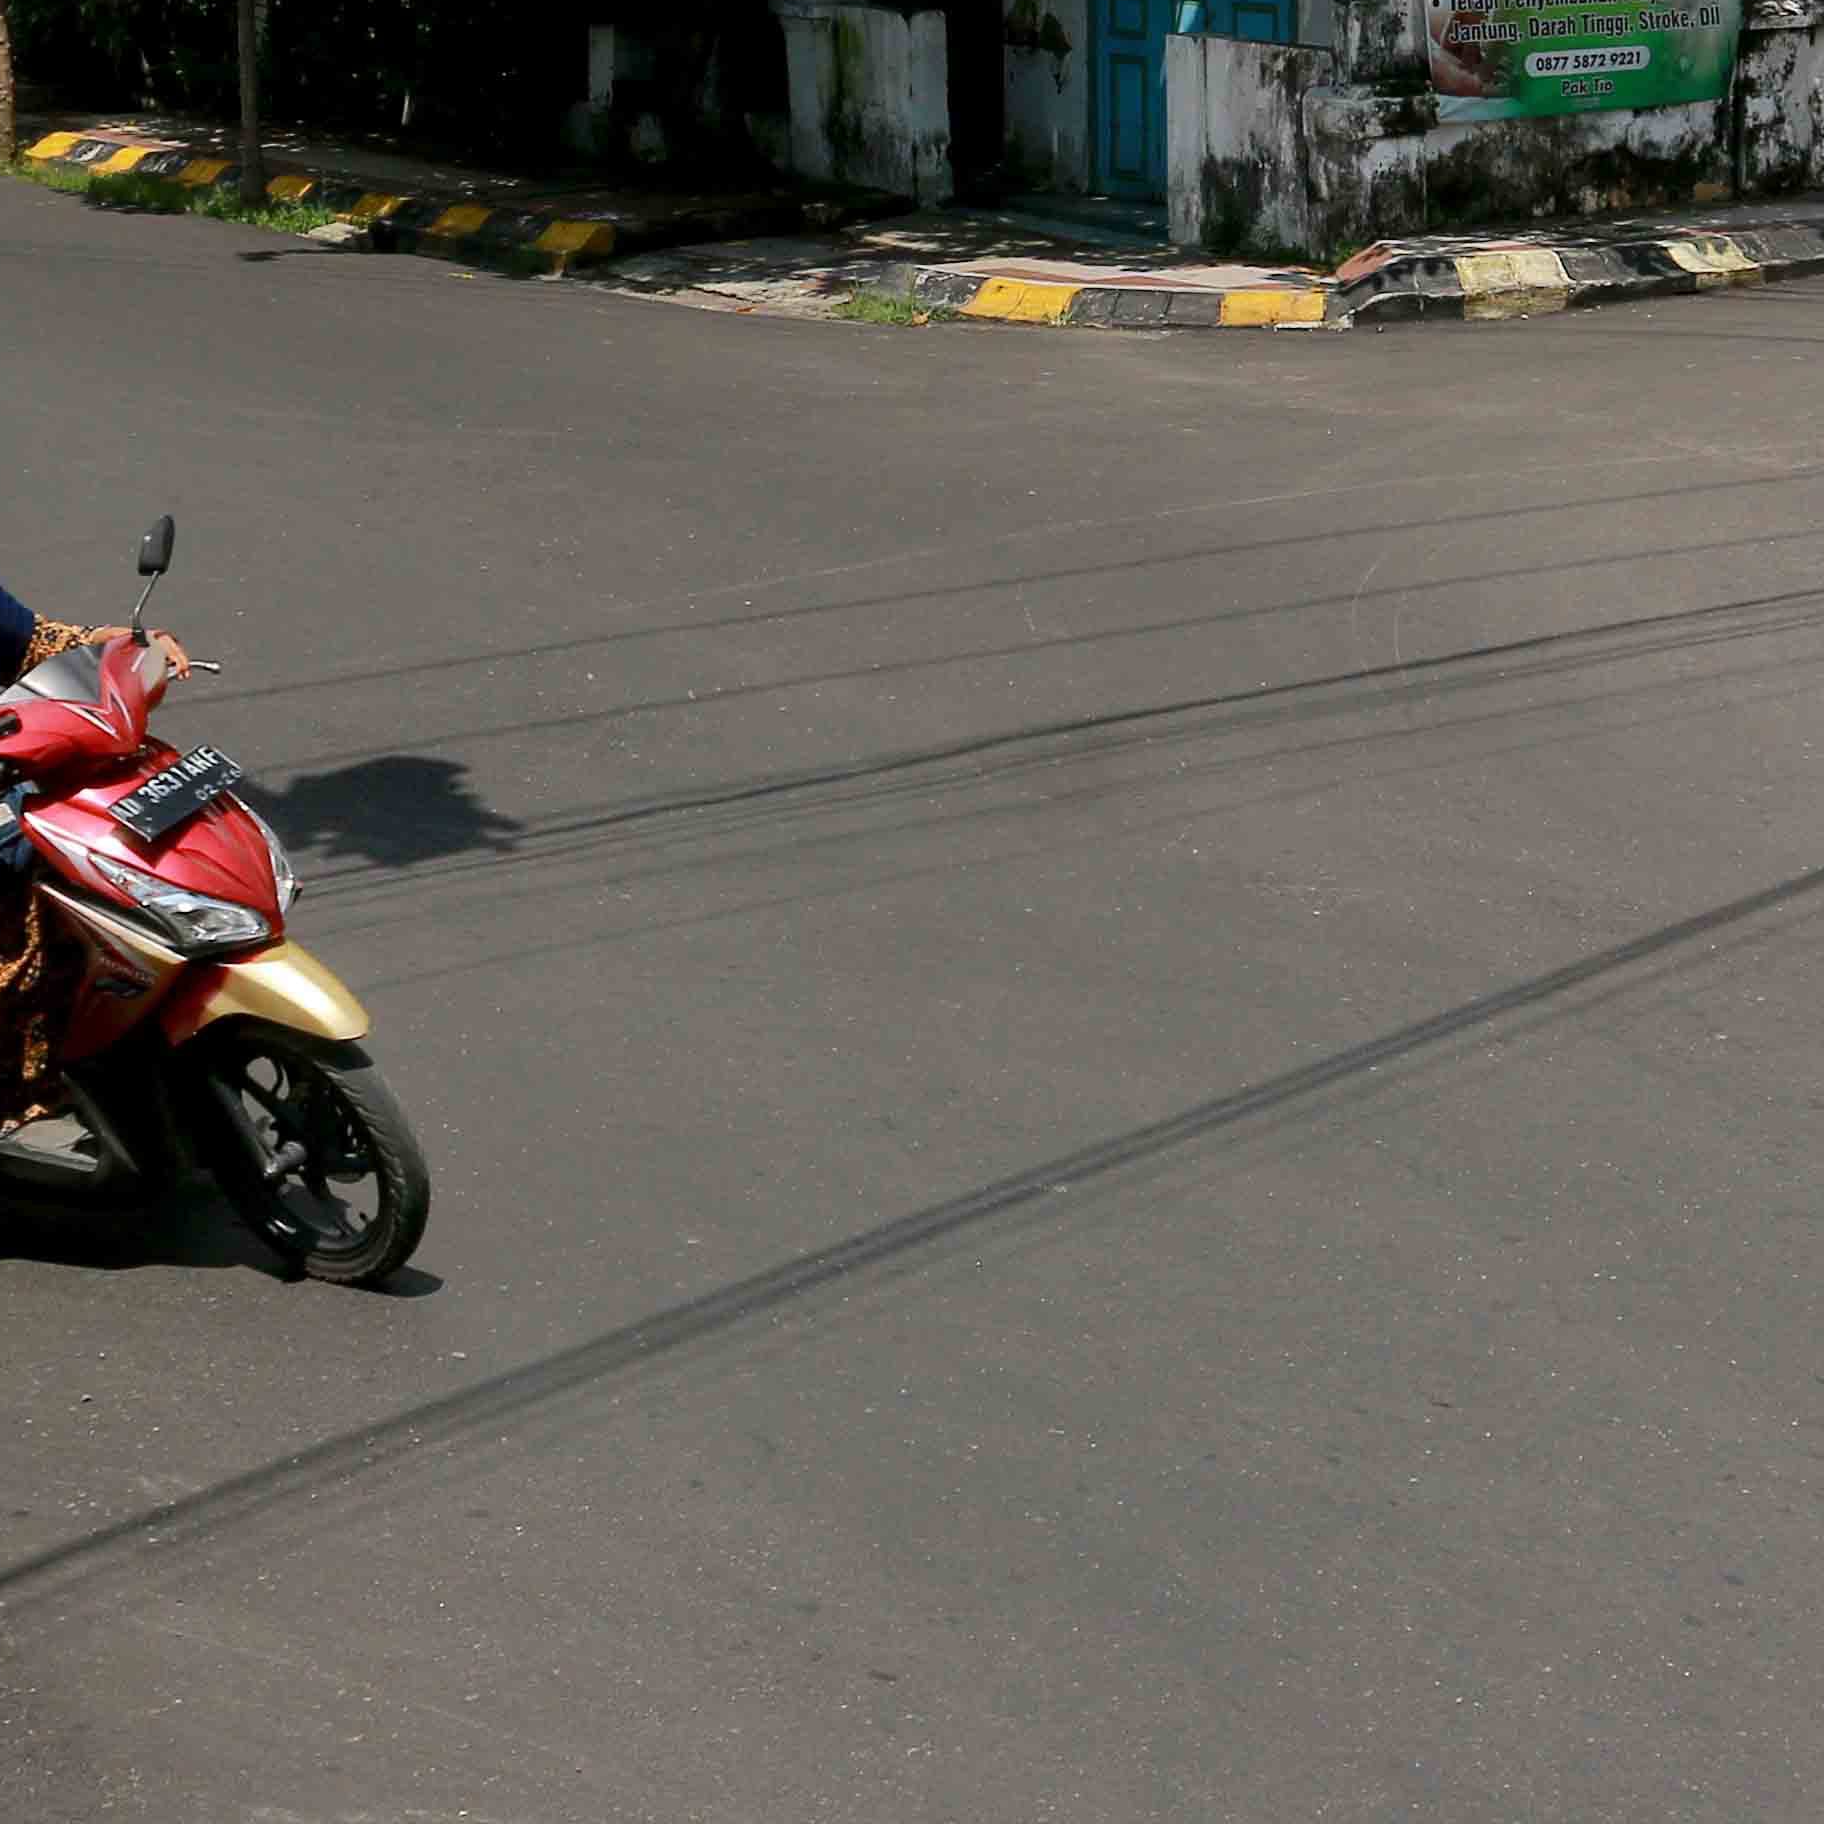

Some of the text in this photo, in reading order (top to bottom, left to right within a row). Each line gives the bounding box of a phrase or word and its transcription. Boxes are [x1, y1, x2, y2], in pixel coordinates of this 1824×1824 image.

[1530, 16, 1577, 37] Darah
[1536, 51, 1641, 71] 0877 5872 9221
[1562, 80, 1587, 95] Pak
[136, 766, 192, 804] 3631
